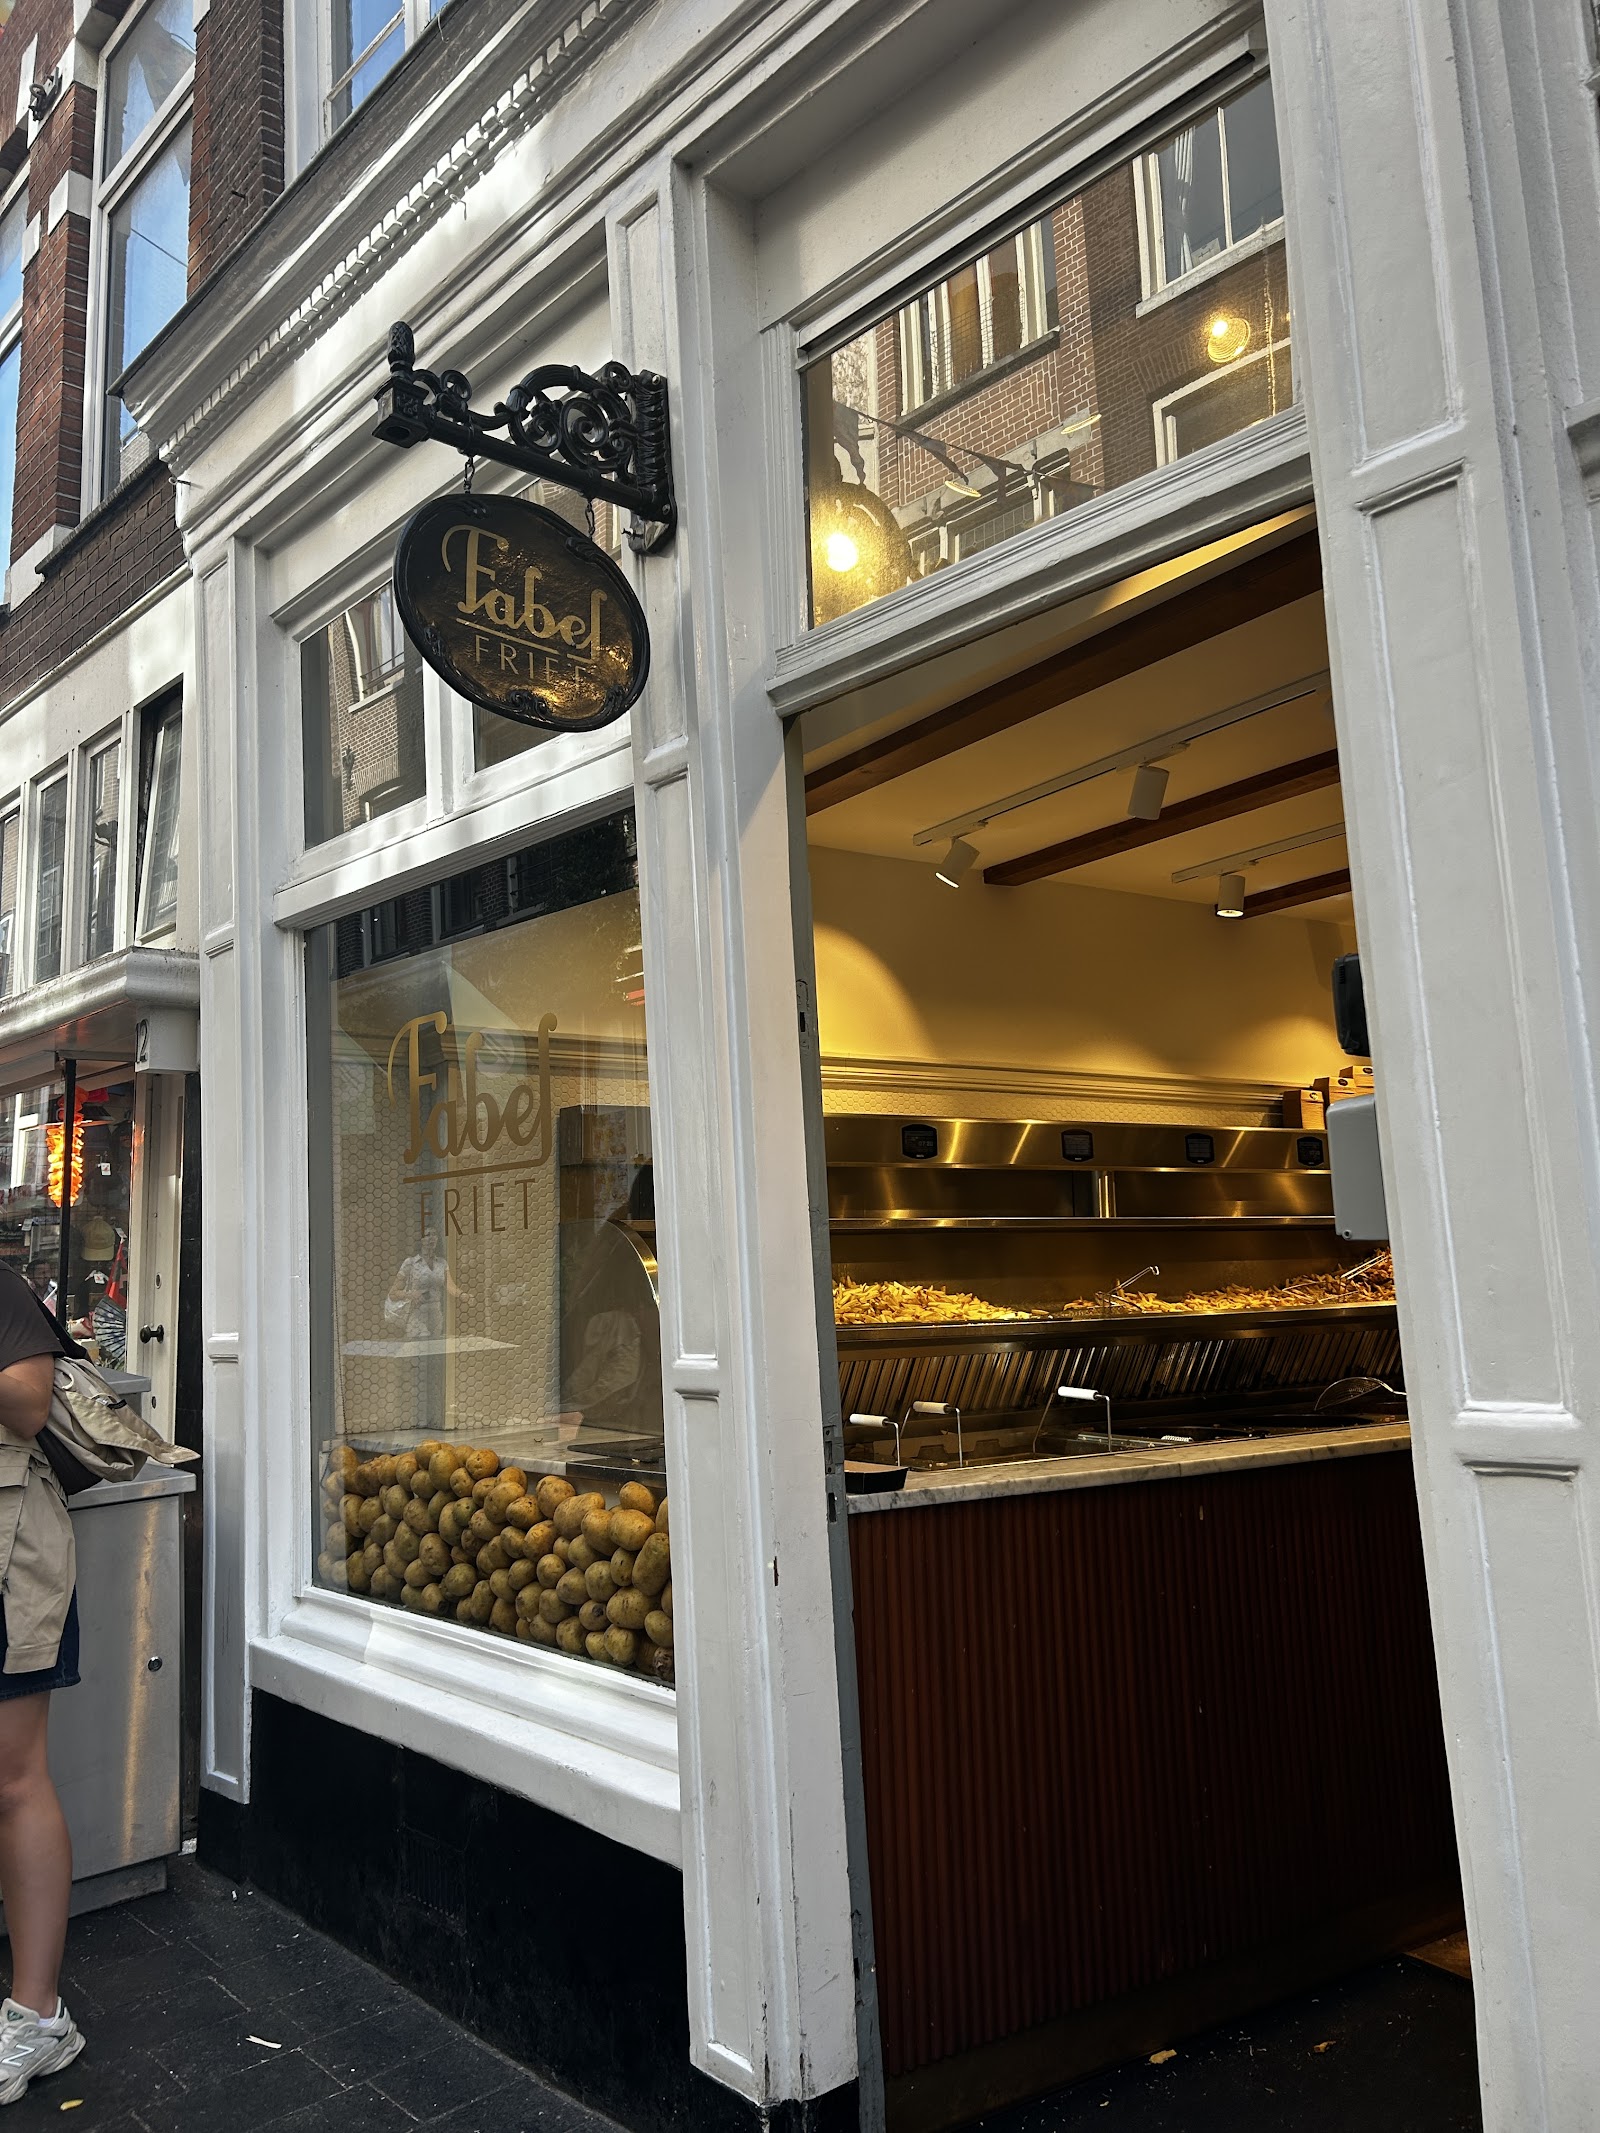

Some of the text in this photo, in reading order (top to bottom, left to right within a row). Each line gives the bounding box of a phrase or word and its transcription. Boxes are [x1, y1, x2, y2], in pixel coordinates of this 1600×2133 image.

[441, 524, 608, 661] Fabel
[135, 1018, 149, 1064] 12
[387, 1010, 558, 1163] Fabel
[420, 1178, 536, 1239] FRIET
